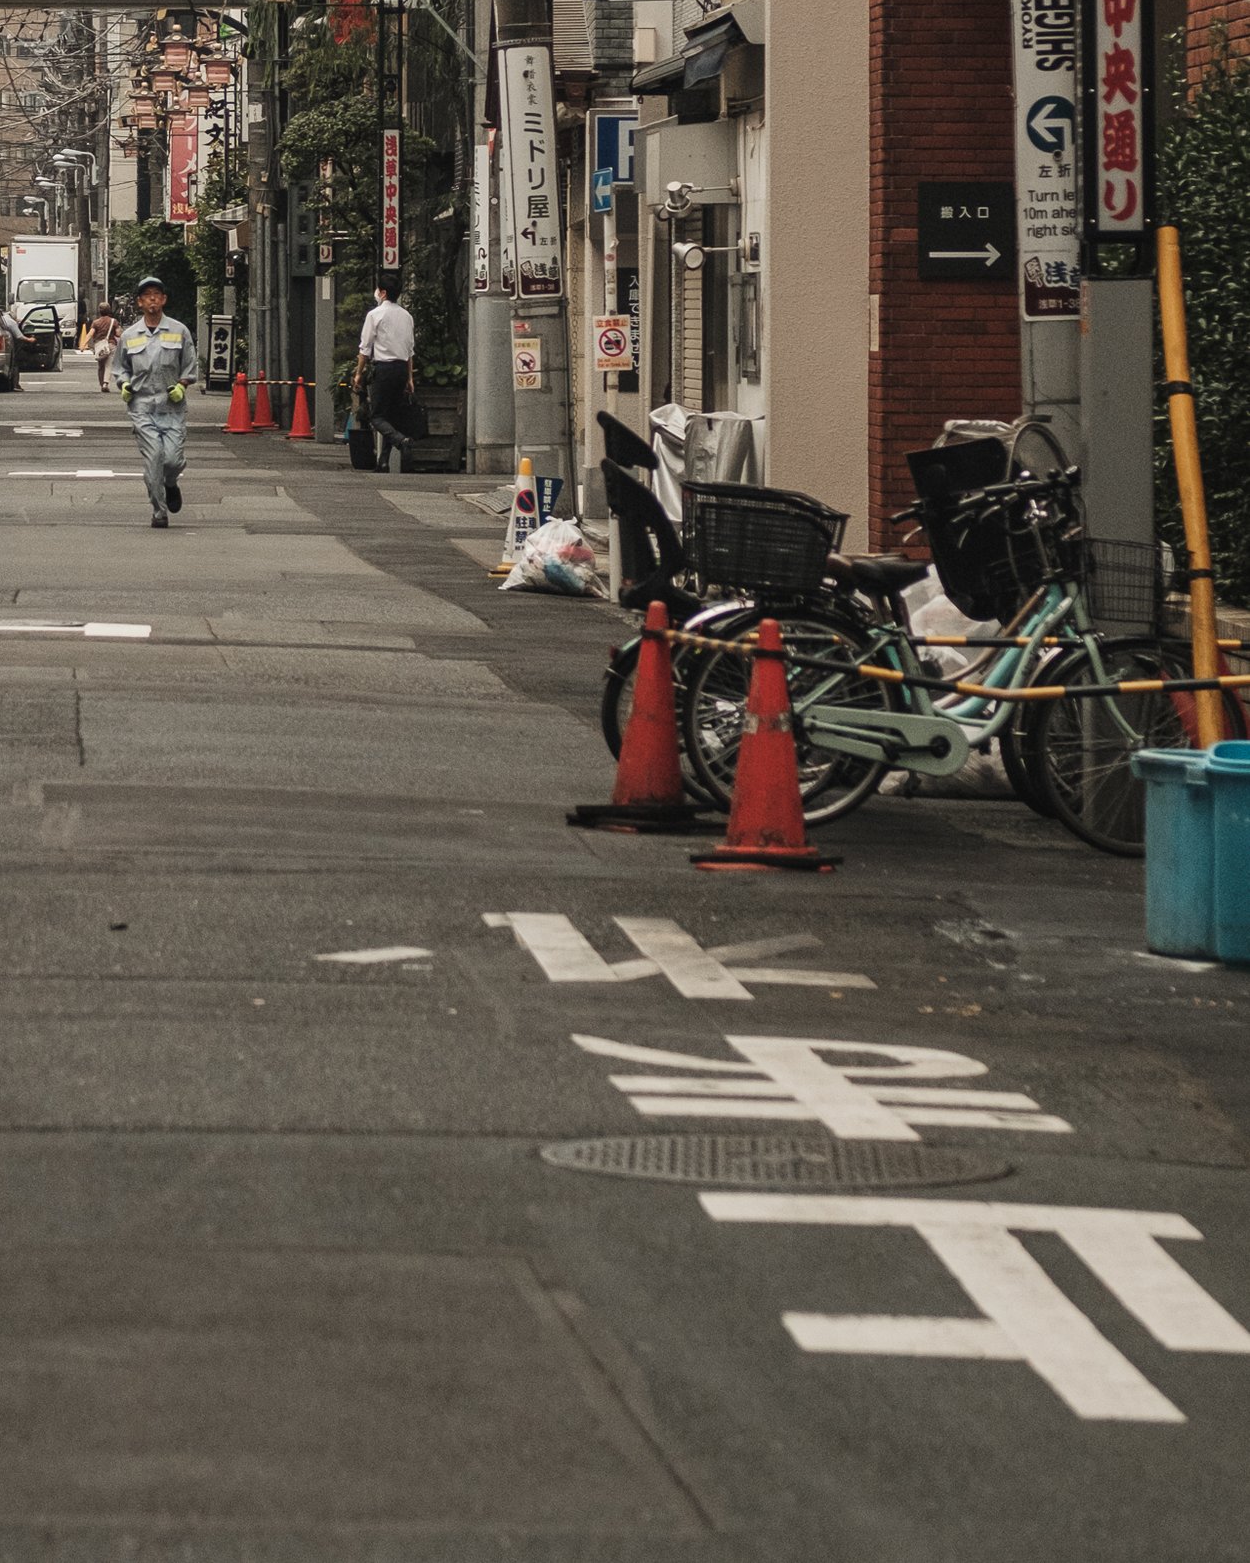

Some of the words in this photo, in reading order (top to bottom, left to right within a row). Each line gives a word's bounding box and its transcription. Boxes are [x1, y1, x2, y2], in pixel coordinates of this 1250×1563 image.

[524, 112, 550, 219] ミドリ屋
[1038, 164, 1071, 178] 左折
[385, 135, 398, 265] 浅草中央通り
[1028, 190, 1059, 203] Turn
[1023, 207, 1048, 220] 10m
[1027, 224, 1058, 239] right
